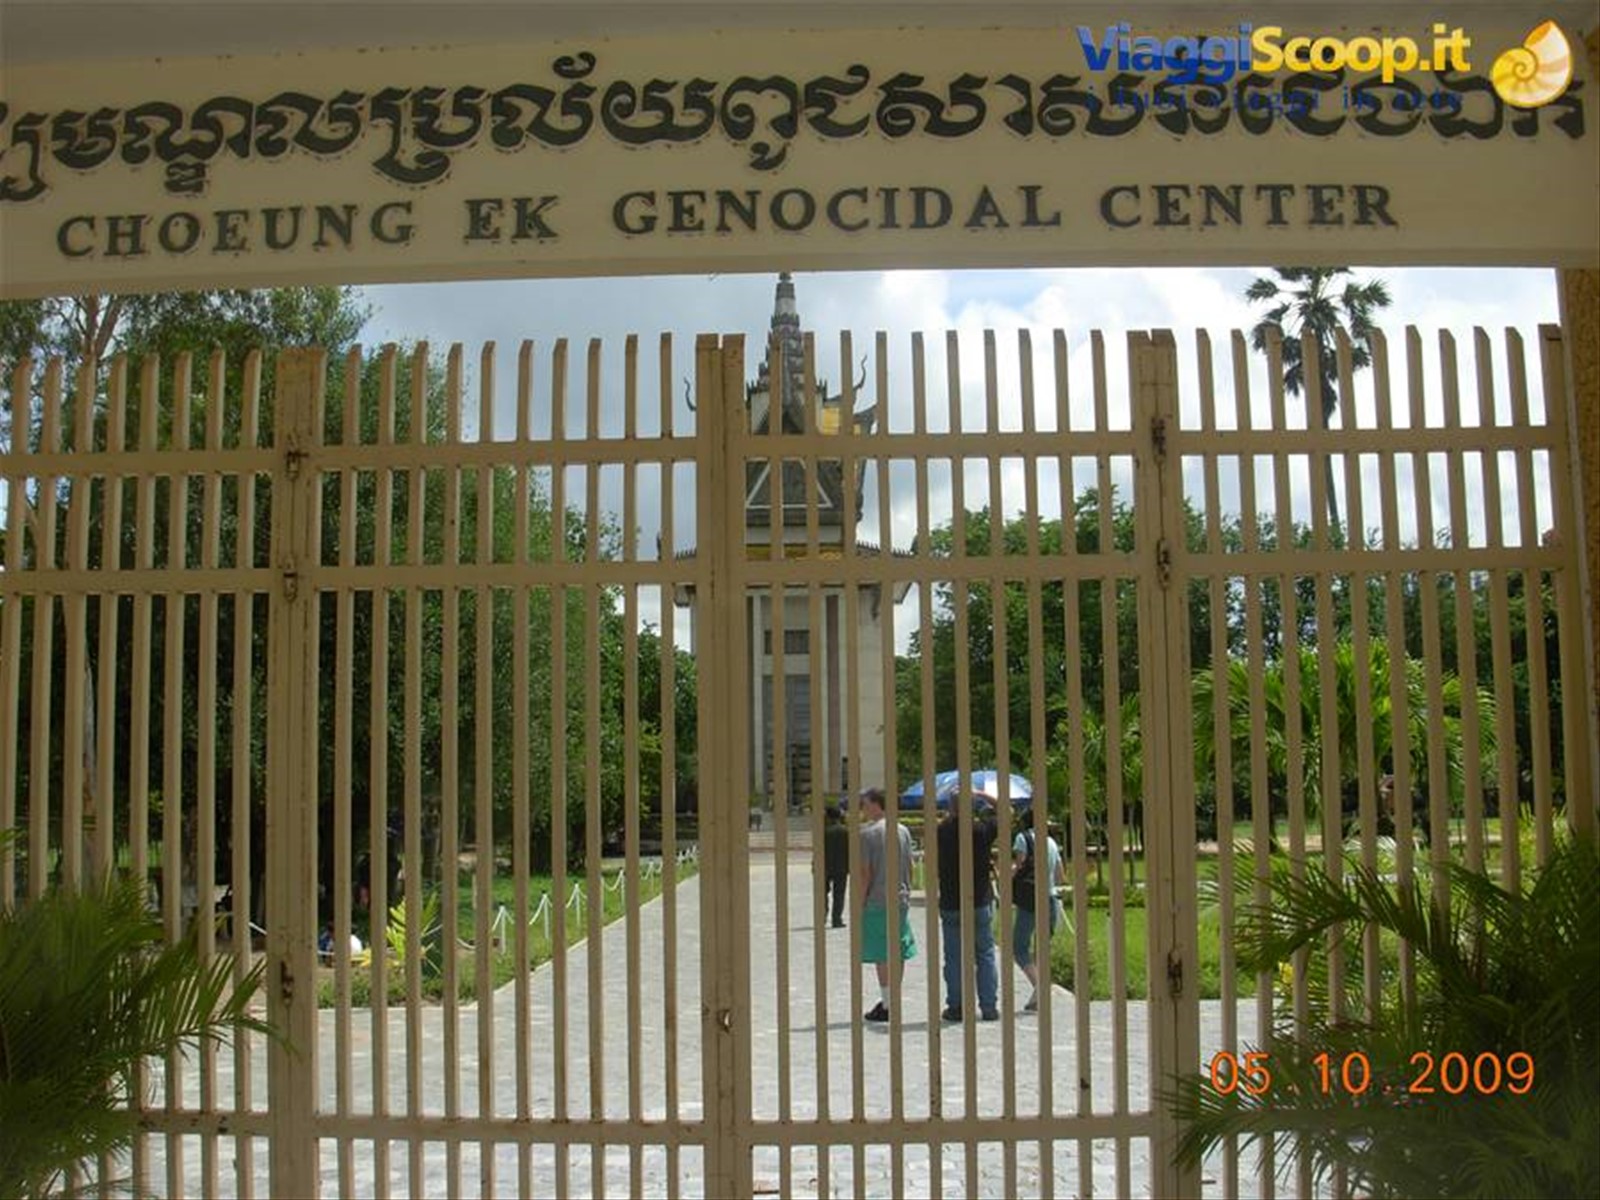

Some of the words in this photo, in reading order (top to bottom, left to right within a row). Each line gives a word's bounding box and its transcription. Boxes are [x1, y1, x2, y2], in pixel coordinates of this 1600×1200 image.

[57, 201, 415, 258] CHOEUNG
[463, 195, 560, 242] EK
[611, 184, 1062, 235] GENOCIDAL
[1099, 183, 1398, 229] CENTER
